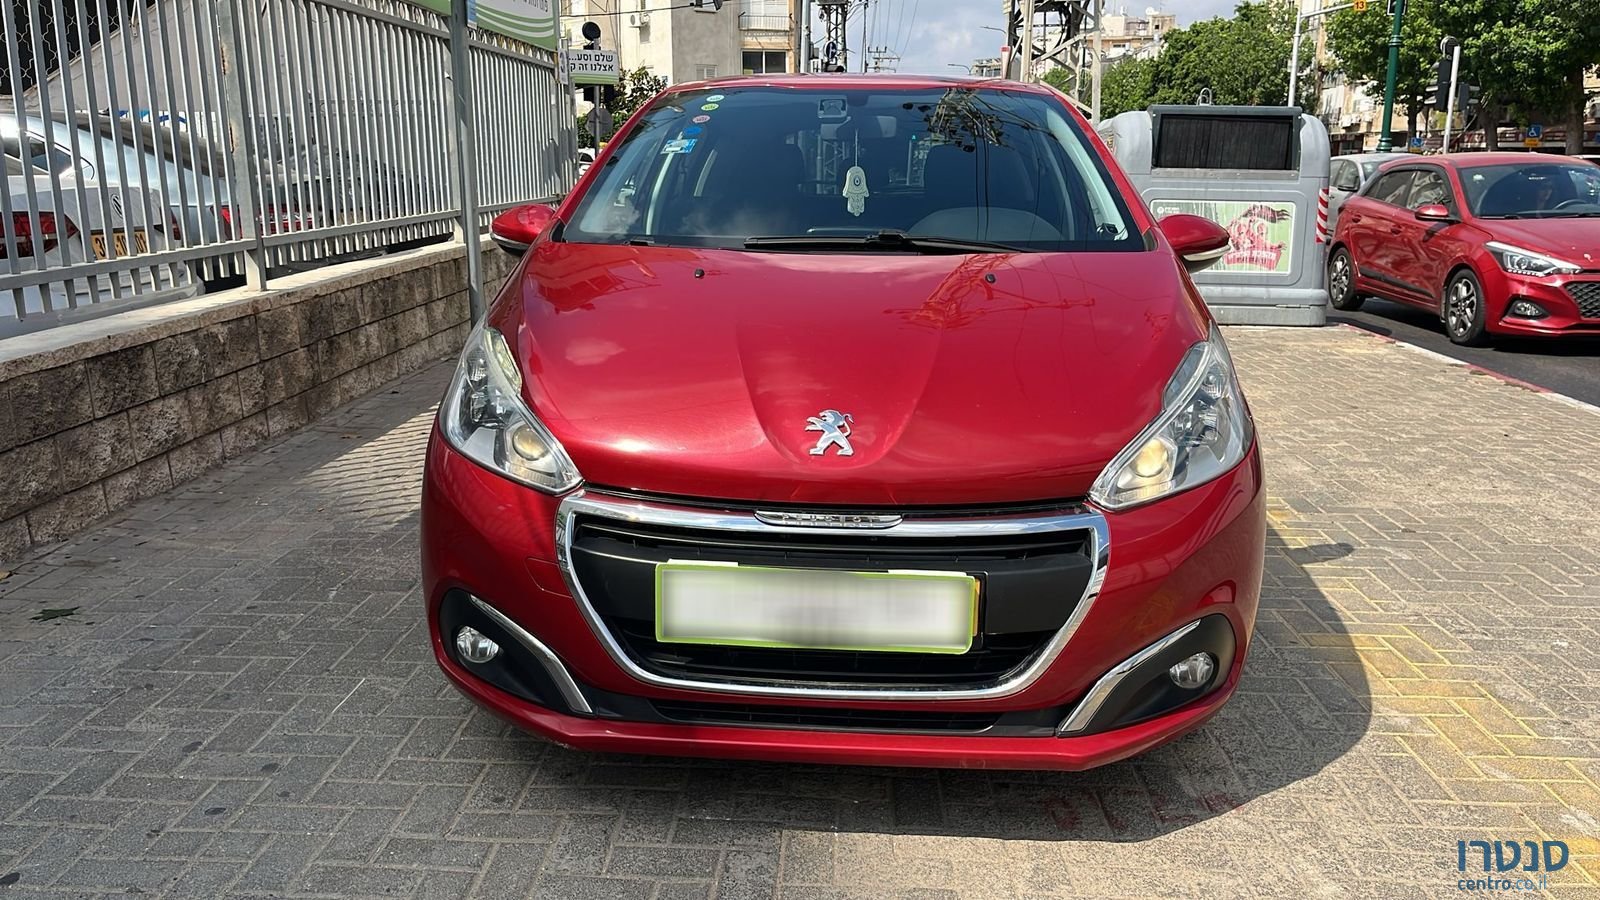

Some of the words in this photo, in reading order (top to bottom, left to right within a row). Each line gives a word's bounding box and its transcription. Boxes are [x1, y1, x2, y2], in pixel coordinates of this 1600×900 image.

[1355, 1, 1365, 9] 13
[594, 53, 613, 62] שלם
[578, 63, 588, 71] זה
[590, 63, 614, 71] אצלנו
